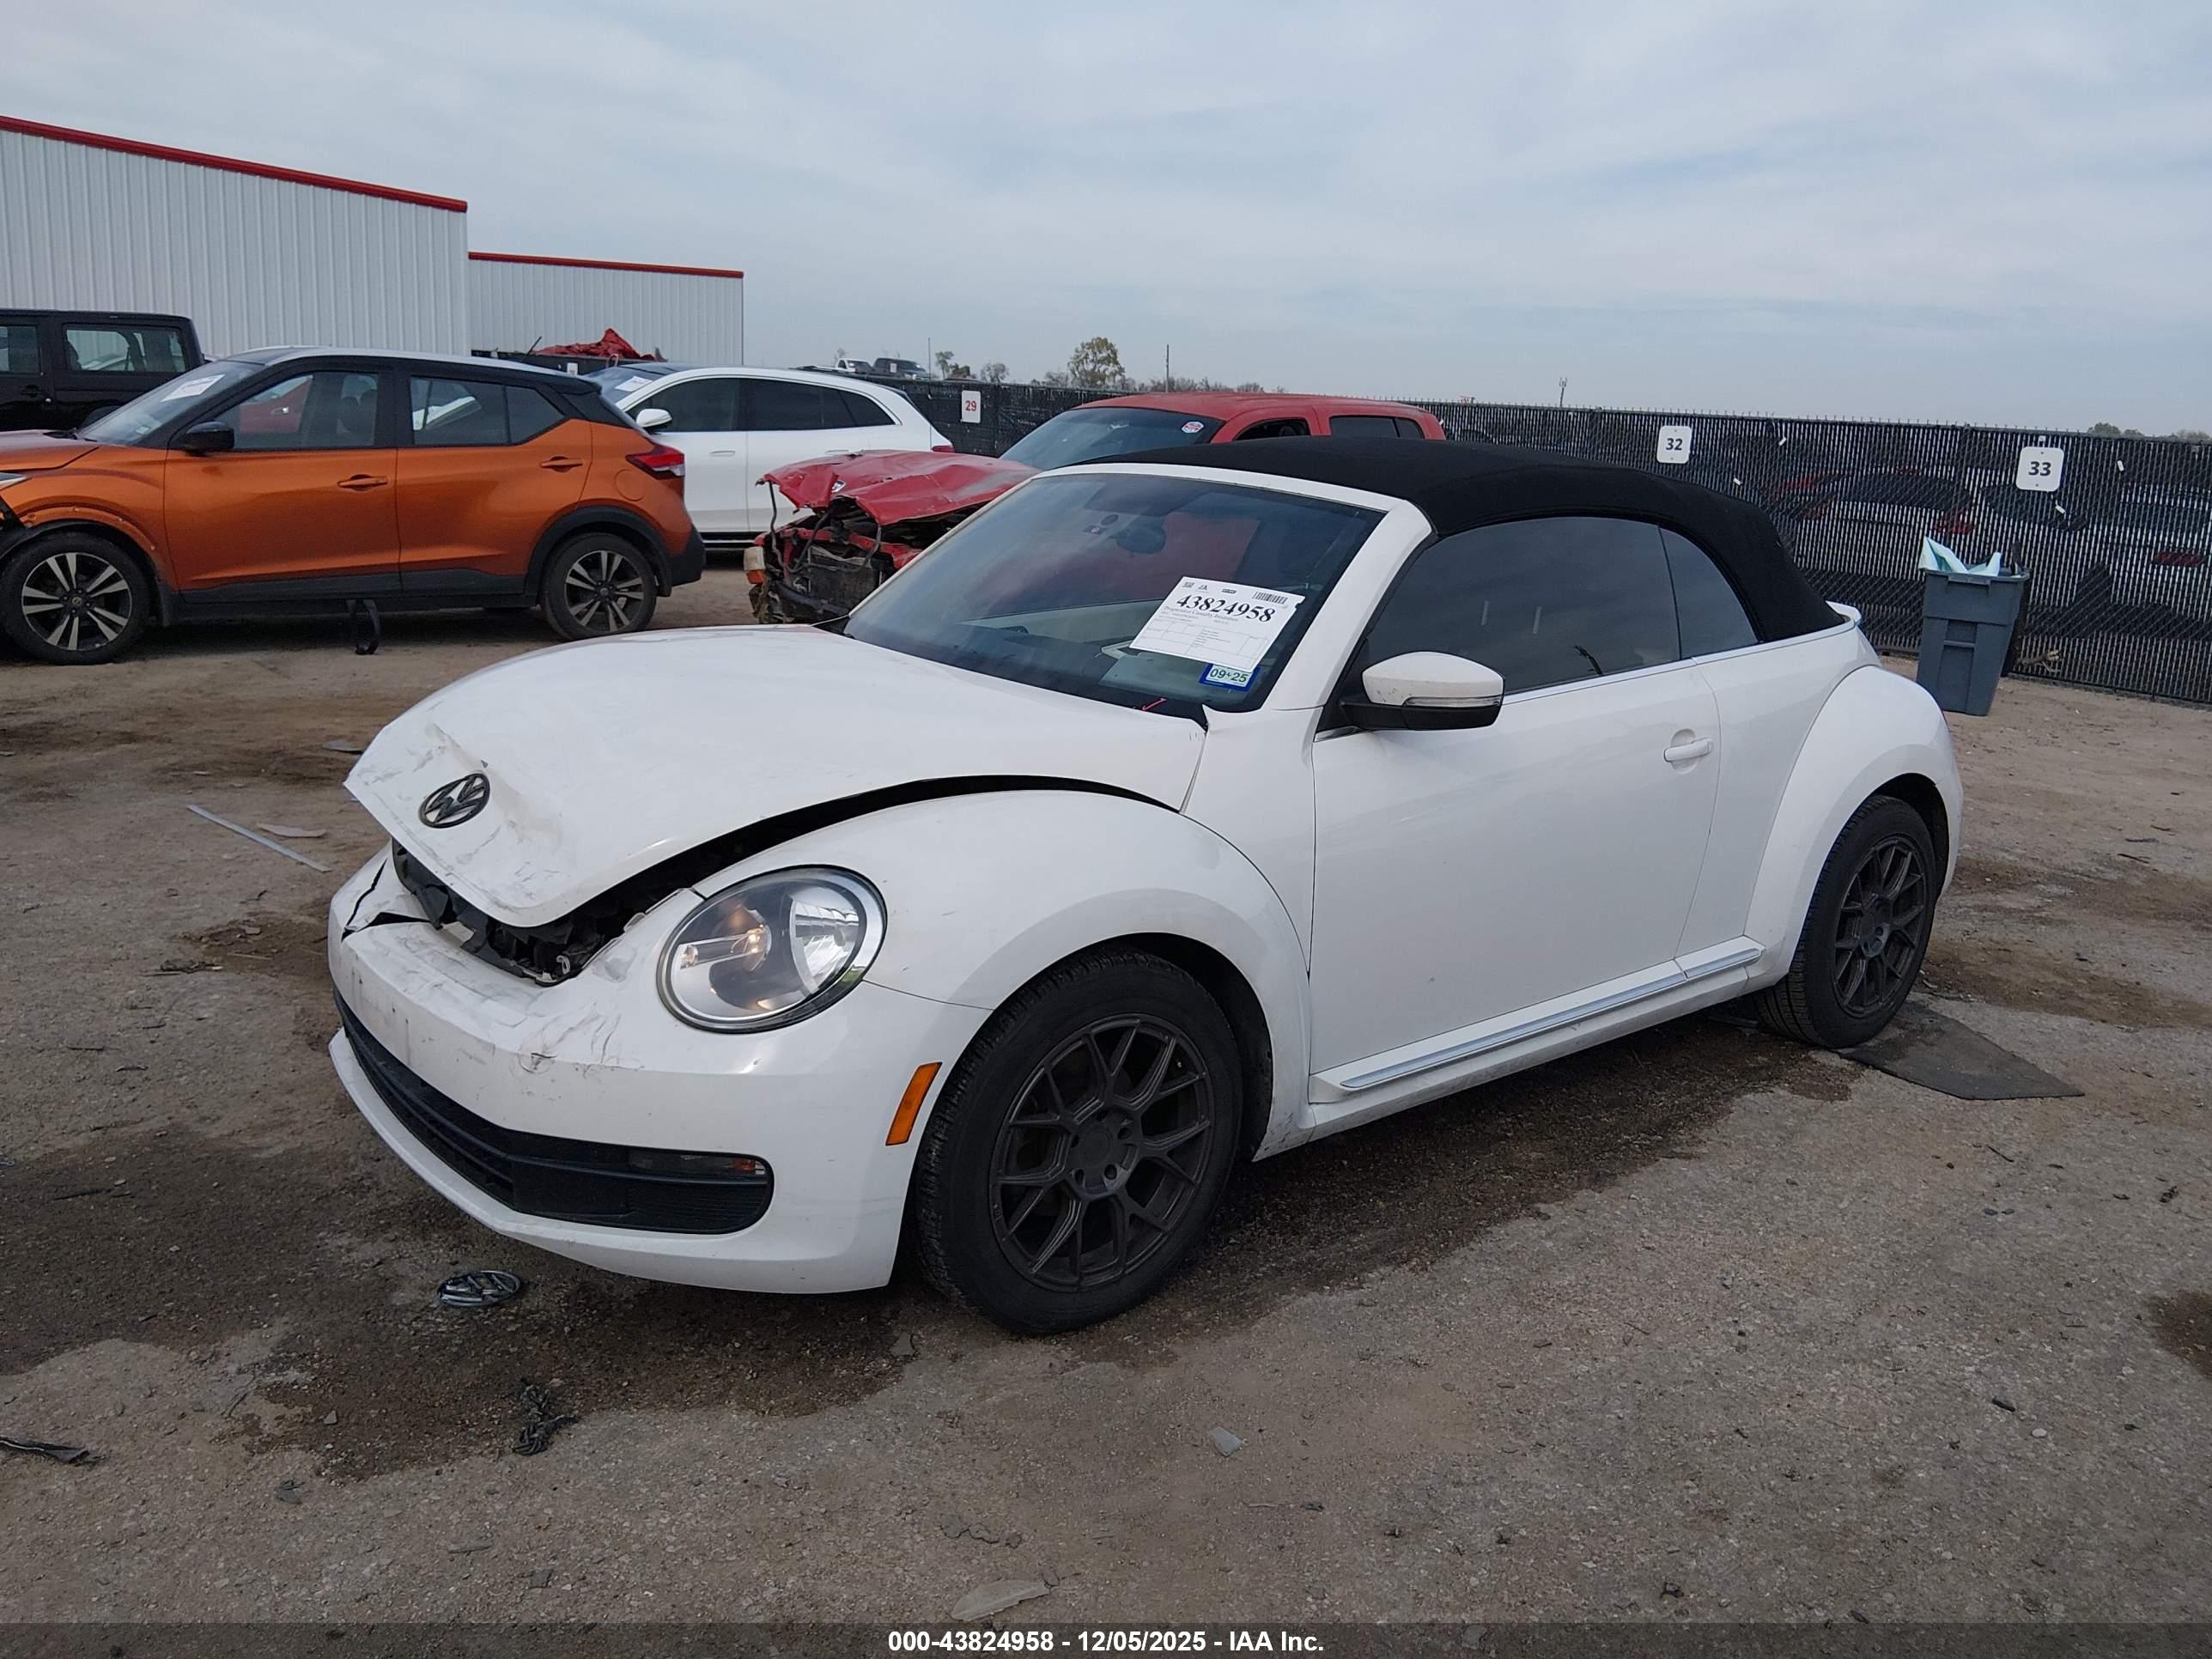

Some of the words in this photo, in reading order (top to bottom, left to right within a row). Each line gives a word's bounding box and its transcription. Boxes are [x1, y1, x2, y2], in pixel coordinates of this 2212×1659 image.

[965, 400, 977, 412] 29
[1665, 437, 1683, 451] 32
[2027, 460, 2052, 477] 33
[1176, 593, 1277, 623] 43824958
